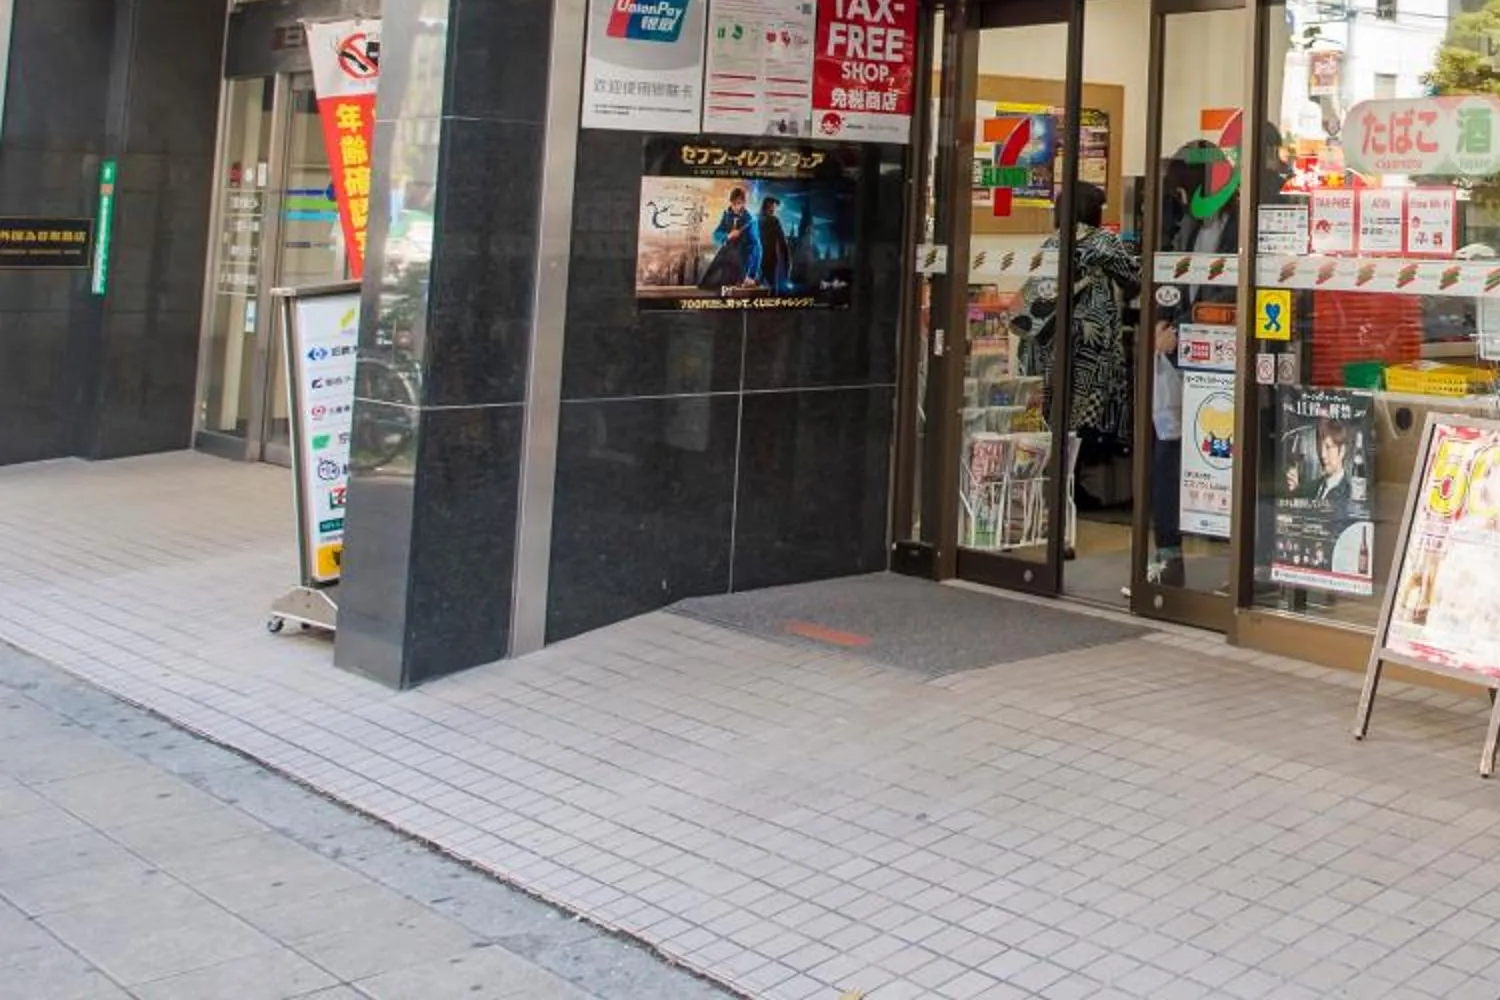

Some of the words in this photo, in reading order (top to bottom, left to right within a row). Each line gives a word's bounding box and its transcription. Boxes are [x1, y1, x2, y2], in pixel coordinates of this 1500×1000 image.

[827, 21, 905, 63] FREE
[841, 61, 890, 83] SHOP
[1361, 108, 1439, 155] たばこ
[1456, 108, 1492, 153] 酒
